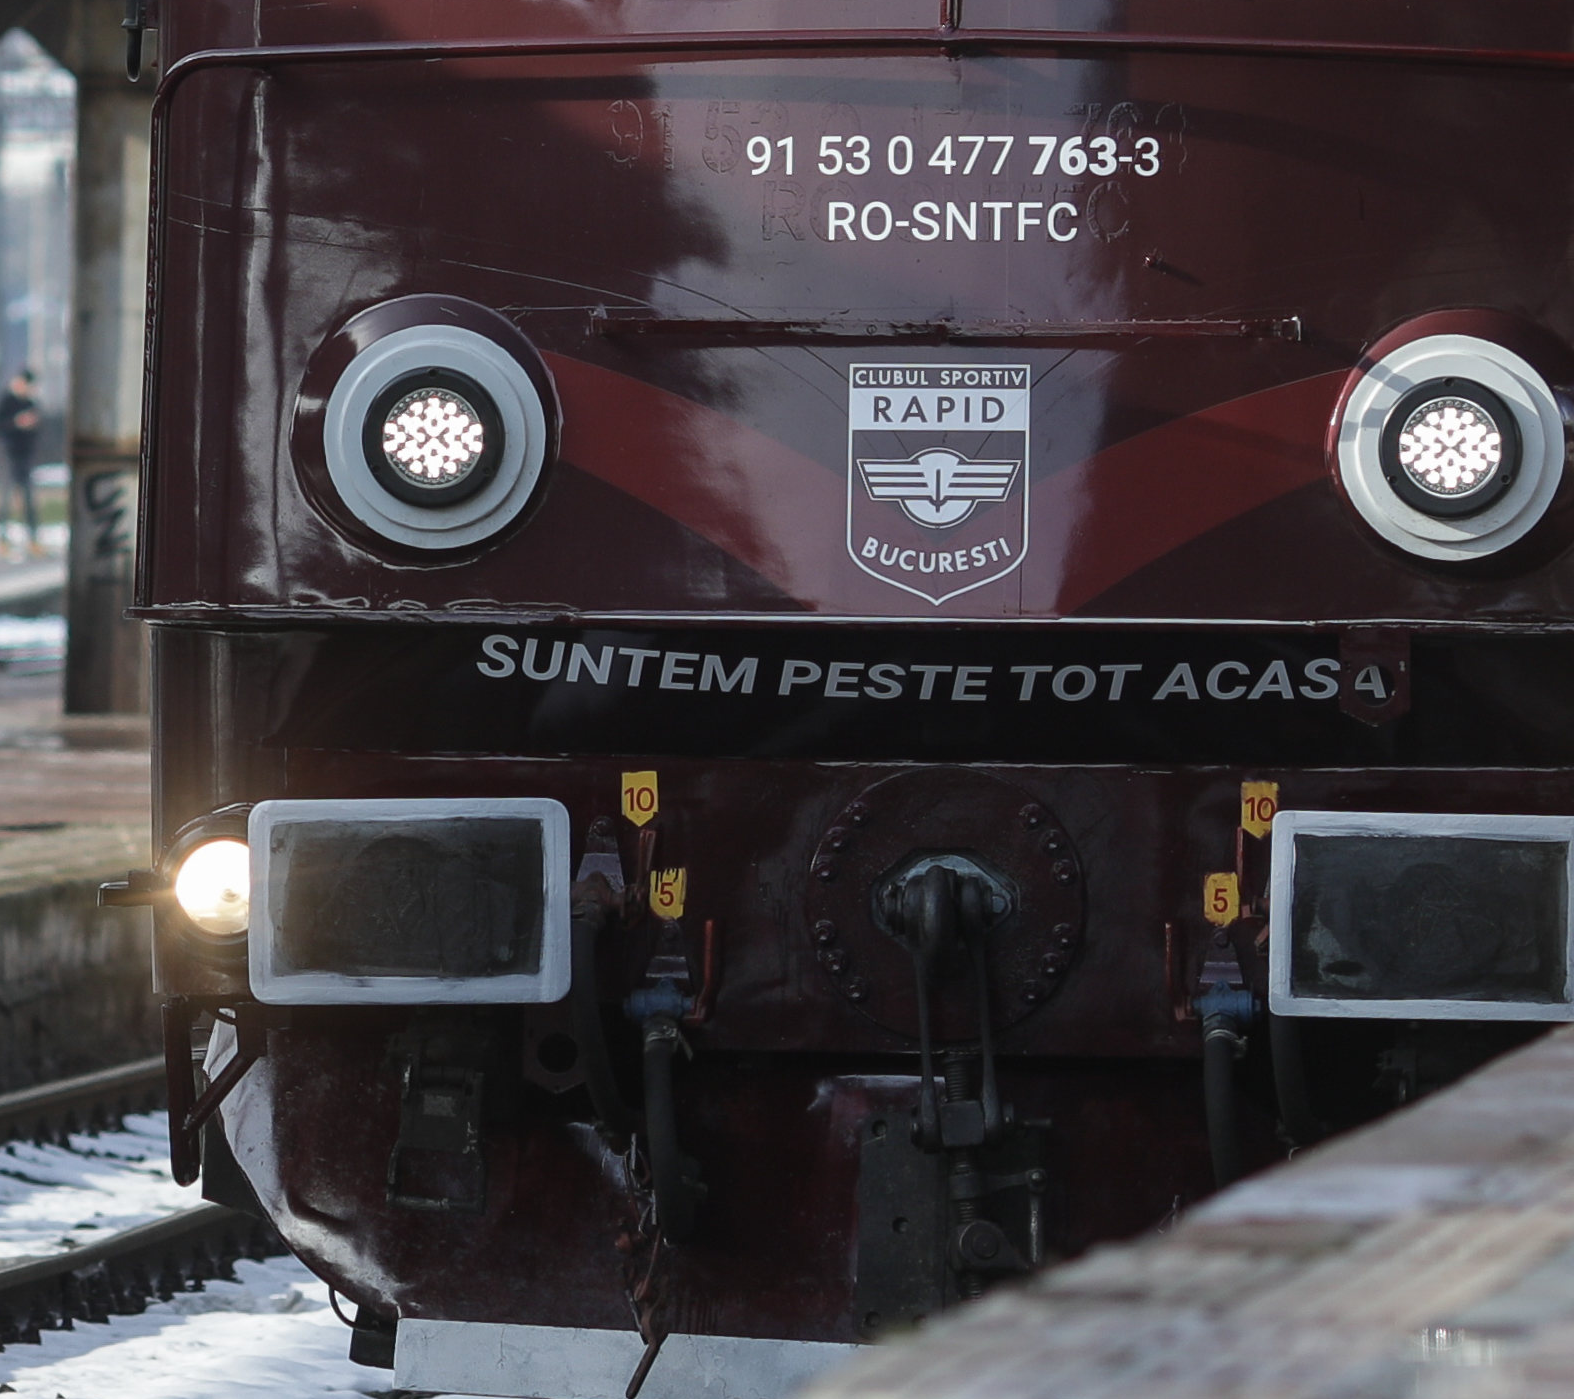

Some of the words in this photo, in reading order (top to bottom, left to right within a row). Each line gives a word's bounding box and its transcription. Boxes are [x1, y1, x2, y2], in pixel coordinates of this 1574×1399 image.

[746, 135, 795, 176] 91
[817, 135, 871, 176] 53
[887, 135, 914, 176] 0
[927, 135, 1015, 176] 477
[1029, 135, 1161, 177] 763-3
[827, 201, 1079, 243] RO-SNTFC
[855, 369, 929, 386] CLUBUL
[940, 369, 1025, 386] SPORTIV
[872, 395, 1005, 424] RAPID
[861, 536, 1012, 574] BUCURESTI
[475, 633, 759, 694] SUNTEM
[777, 659, 993, 702] PESTE
[1009, 663, 1143, 702] TOT
[623, 786, 656, 812] 10
[1244, 796, 1277, 822] 10
[658, 882, 675, 907] 5
[1212, 888, 1229, 913] 5
